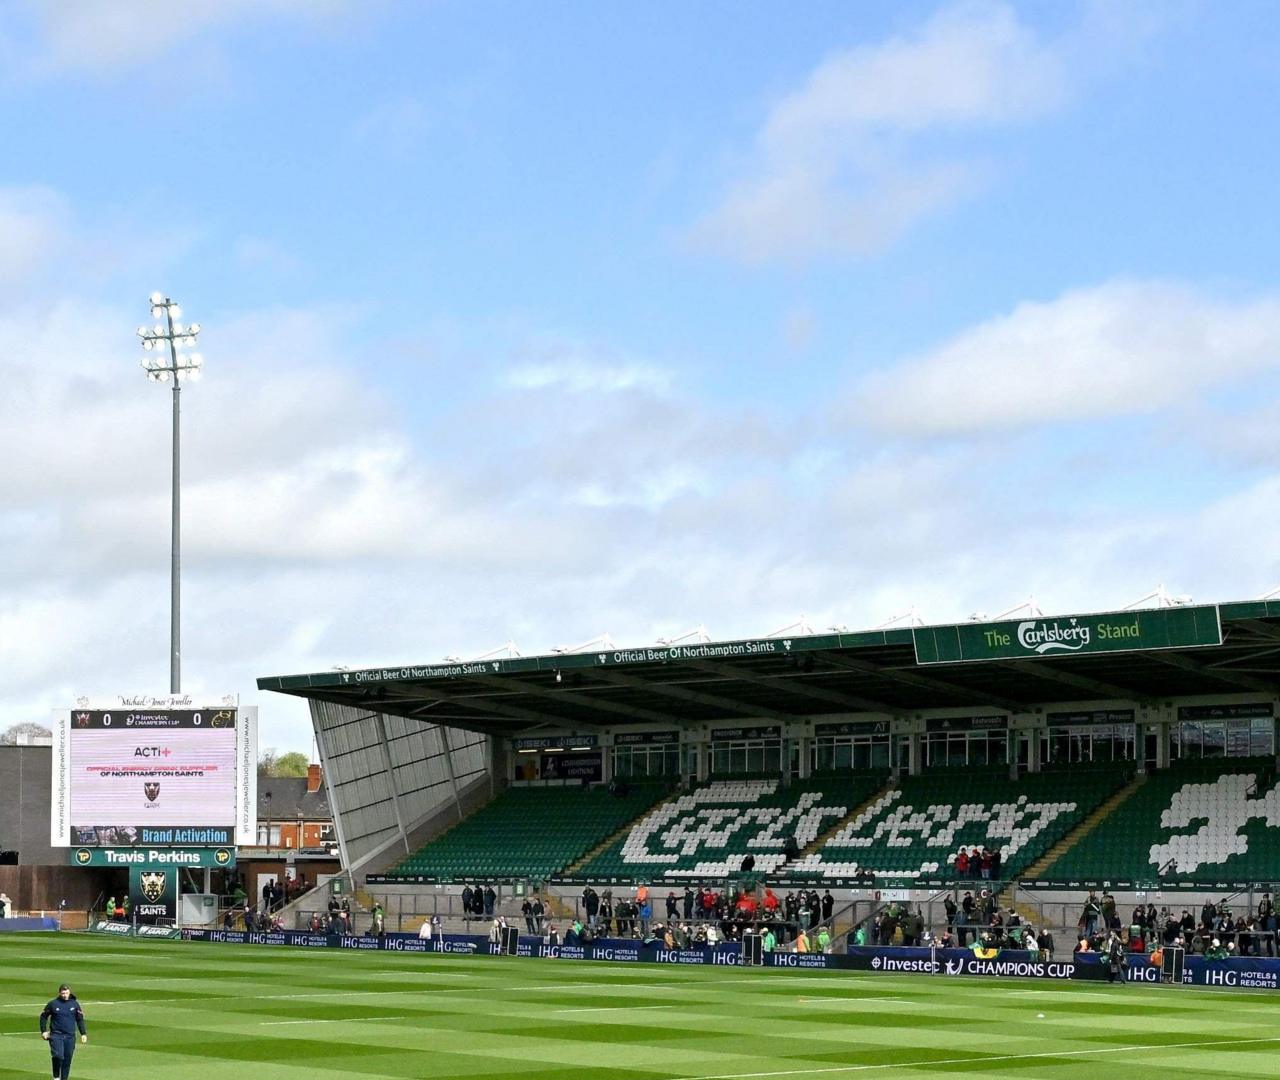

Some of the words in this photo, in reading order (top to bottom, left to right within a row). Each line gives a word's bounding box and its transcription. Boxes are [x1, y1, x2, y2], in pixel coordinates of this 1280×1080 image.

[984, 630, 1010, 647] The
[1018, 618, 1090, 654] Carlsberg
[1097, 622, 1140, 638] Stand
[614, 649, 646, 663] Official
[648, 647, 668, 660] Beer
[670, 646, 682, 660] Of
[683, 644, 744, 658] Northampton
[746, 642, 774, 654] Saints
[355, 670, 380, 682] Official
[382, 668, 400, 680] Beer
[401, 667, 410, 678] Of
[412, 664, 462, 678] Northampton
[462, 662, 486, 674] Saints
[118, 696, 144, 706] Michael
[103, 714, 112, 725] 0
[194, 713, 201, 724] 0
[142, 830, 172, 842] Brand
[174, 830, 228, 842] Activation
[104, 850, 144, 863] Travis
[149, 850, 200, 863] Perkins
[774, 955, 796, 966] IHG
[883, 956, 939, 972] Investec
[968, 961, 1045, 976] CHAMPIONS
[1048, 963, 1075, 977] CUP
[1206, 970, 1236, 985] IHG
[1241, 972, 1269, 980] HOTELS
[1240, 980, 1276, 988] RESORTS
